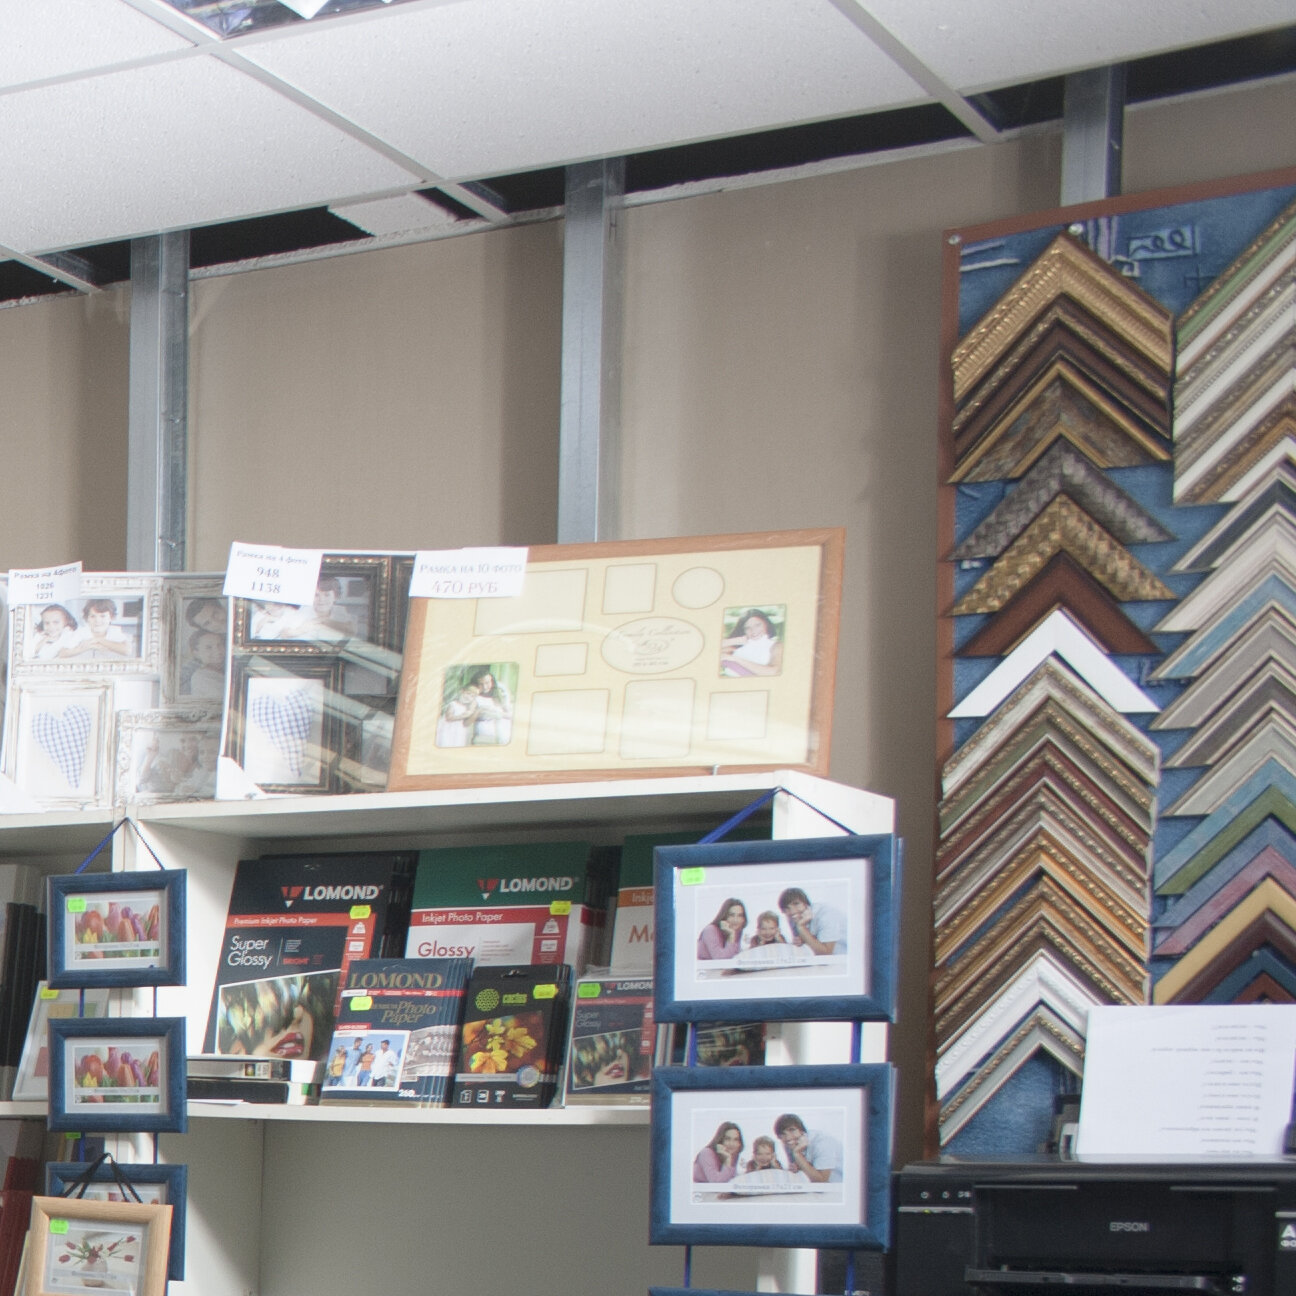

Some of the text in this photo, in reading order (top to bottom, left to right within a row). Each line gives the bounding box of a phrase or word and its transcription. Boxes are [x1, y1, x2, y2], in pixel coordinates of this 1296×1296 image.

[236, 550, 264, 560] Рамка
[285, 556, 309, 565] фото
[14, 571, 40, 579] Рамка
[256, 566, 280, 578] 948
[419, 563, 522, 574] РАМКА НА 10 ФОТО
[250, 580, 281, 594] 1138
[431, 579, 499, 593] 470 РУБ
[500, 876, 573, 893] LOMOND
[303, 885, 379, 900] LOMOND
[233, 917, 259, 925] Premium
[279, 916, 297, 924] Photo
[298, 917, 318, 926] Paper
[422, 911, 503, 925] Inkjet Photo Paper
[230, 935, 269, 953] Super
[418, 940, 475, 959] Glossy
[227, 949, 273, 970] Glossy
[349, 972, 443, 989] LOMOND
[396, 1000, 437, 1015] Photo
[381, 1010, 425, 1025] Paper
[1110, 1222, 1148, 1232] EPSON
